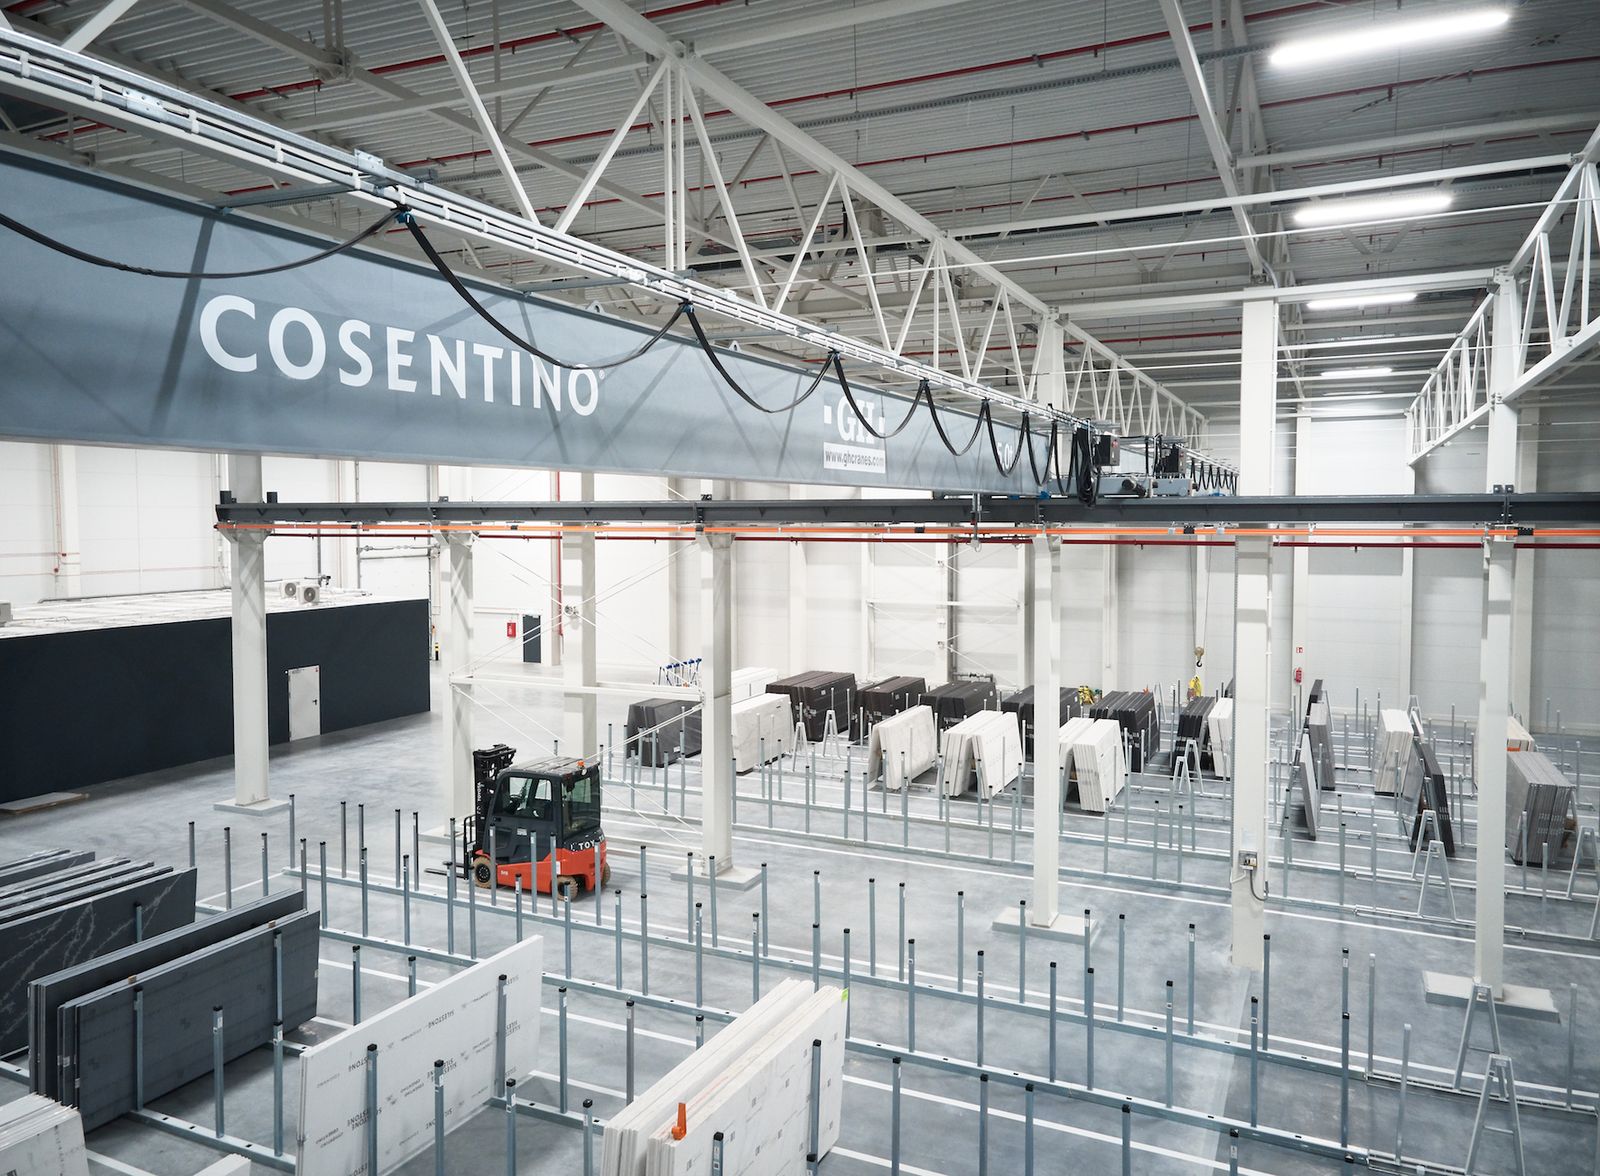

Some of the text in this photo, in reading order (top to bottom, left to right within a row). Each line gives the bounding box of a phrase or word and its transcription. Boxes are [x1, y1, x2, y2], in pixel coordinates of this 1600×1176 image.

[199, 294, 599, 417] COSENTINO
[837, 396, 875, 445] GH
[578, 834, 605, 851] TOYTA
